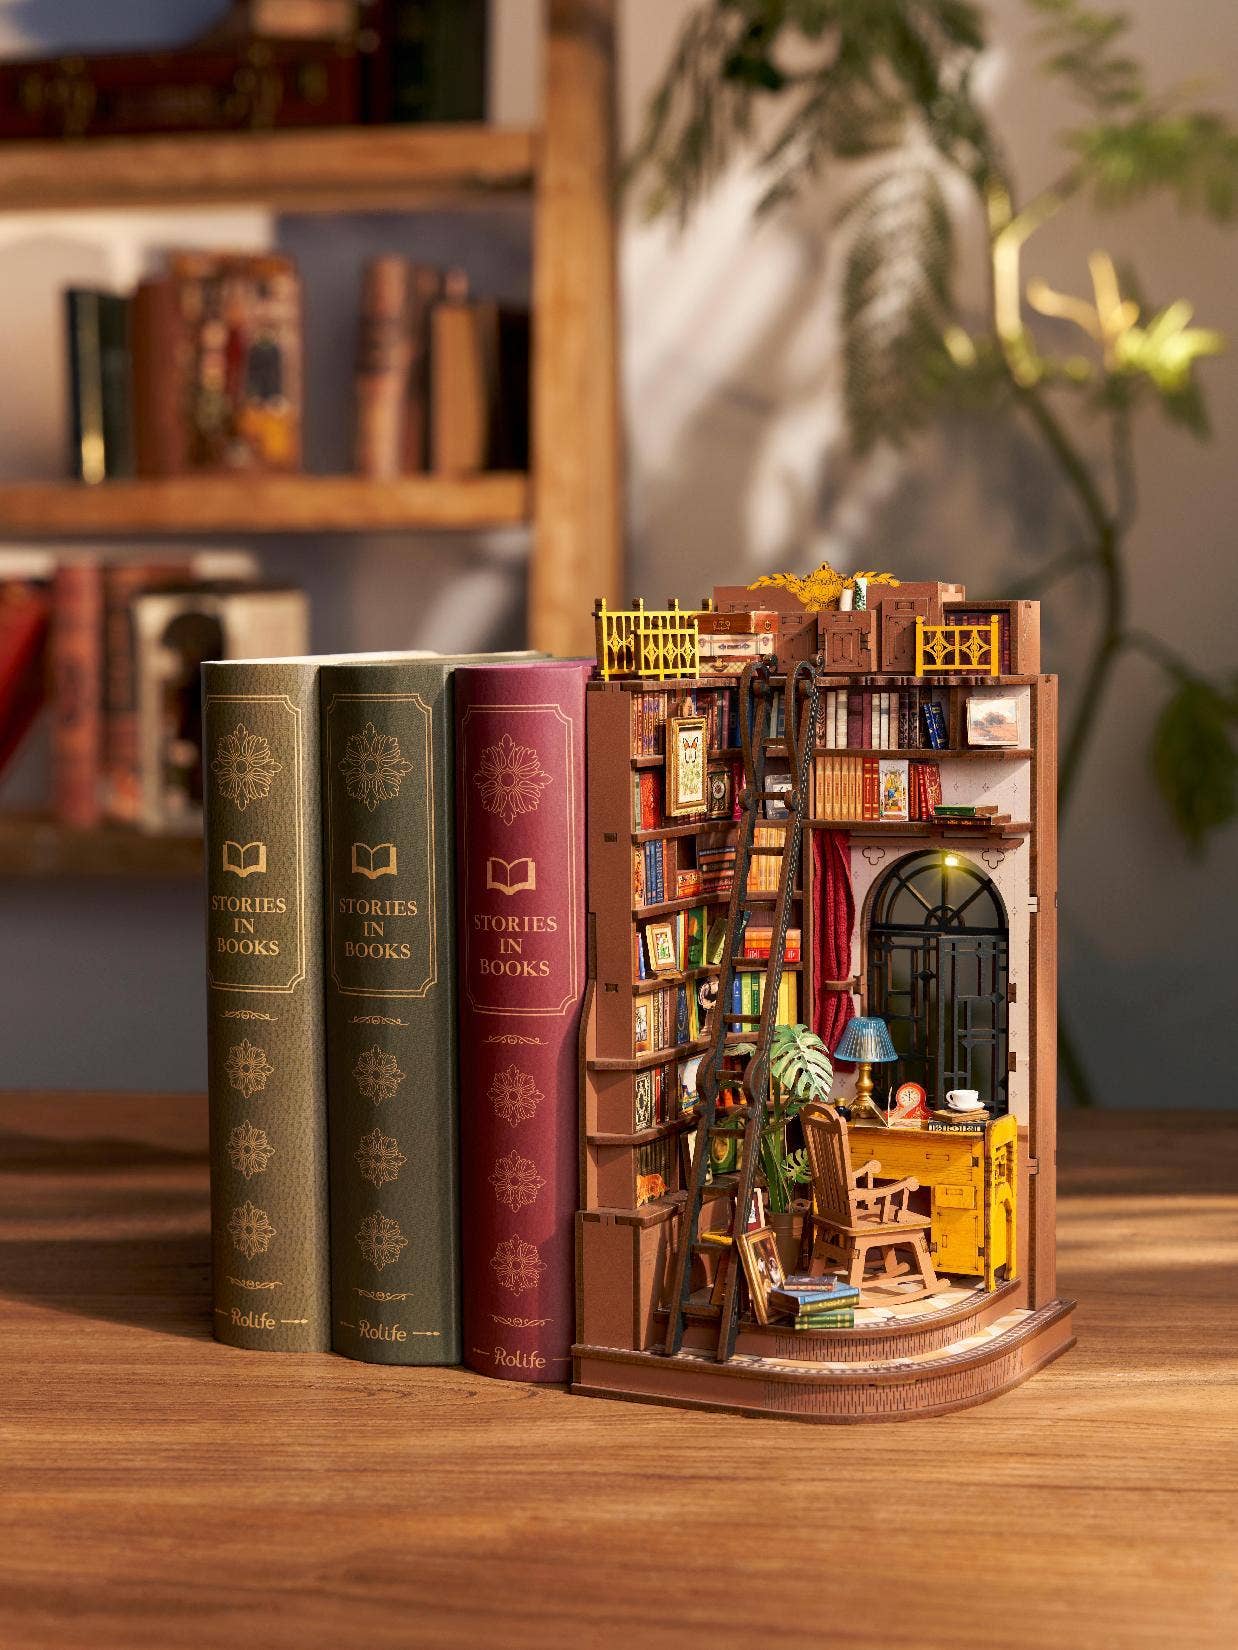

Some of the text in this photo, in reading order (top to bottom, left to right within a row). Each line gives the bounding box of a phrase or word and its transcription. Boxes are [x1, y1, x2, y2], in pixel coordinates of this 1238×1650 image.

[211, 895, 287, 913] STORIES
[339, 898, 418, 915] STORIES
[233, 918, 255, 934] IN
[363, 921, 384, 937] IN
[474, 914, 558, 932] STORIES
[217, 938, 280, 956] BOOKS
[345, 941, 411, 959] BOOKS
[499, 938, 523, 954] IN
[480, 958, 550, 977] BOOKS
[231, 1307, 276, 1330] Rolife
[359, 1319, 407, 1342] Rolife
[494, 1346, 546, 1369] Rolife
